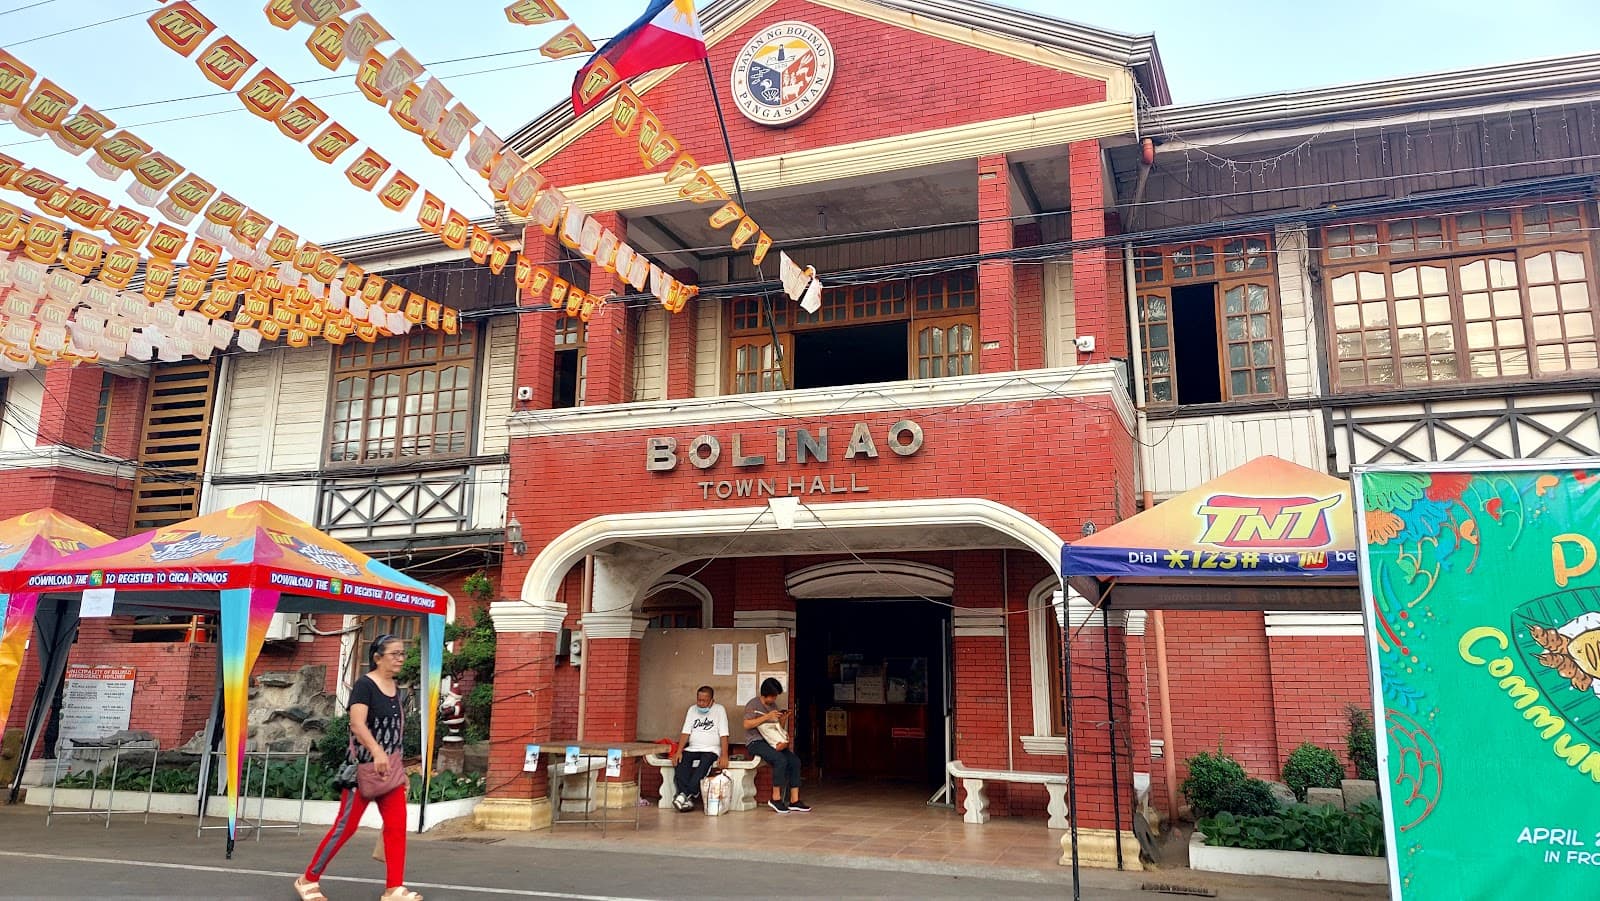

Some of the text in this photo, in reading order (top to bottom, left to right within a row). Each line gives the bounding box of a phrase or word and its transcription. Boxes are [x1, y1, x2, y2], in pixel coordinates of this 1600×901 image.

[156, 9, 207, 40] TNT
[314, 25, 343, 55] TN
[738, 26, 826, 72] BAYAN NG BOLINAO
[204, 46, 248, 75] TNT
[360, 62, 378, 88] TN
[244, 81, 288, 107] TNT
[739, 77, 824, 118] PANGASINAN
[28, 93, 70, 118] TNT
[395, 93, 411, 118] TN
[615, 101, 637, 124] TNT
[63, 115, 104, 136] TNT
[279, 107, 320, 130] TNT
[103, 140, 144, 158] TNT
[314, 133, 350, 154] TNT
[136, 159, 177, 180] TNT
[351, 162, 384, 180] TNT
[21, 176, 59, 191] TNT
[174, 183, 210, 202] TNT
[384, 184, 413, 202] TNT
[66, 197, 105, 216] TNT
[212, 201, 242, 217] TNT
[422, 205, 441, 223] TNT
[109, 215, 142, 231] TNT
[28, 226, 61, 243] TNT
[152, 234, 184, 250] TNT
[72, 242, 101, 257] TNT
[189, 247, 218, 265] TNT
[272, 238, 294, 256] TNT
[108, 253, 134, 271] TNT
[298, 249, 318, 267] TNT
[149, 269, 171, 285] TNT
[232, 264, 254, 280] TNT
[181, 278, 203, 295] TNT
[264, 277, 283, 292] TNT
[213, 292, 236, 306] TNT
[248, 299, 266, 315] TNT
[275, 308, 292, 323] TNT
[646, 419, 924, 471] BOLINAO
[698, 473, 869, 500] TOWN HALL
[1197, 494, 1342, 544] TNT
[1128, 551, 1158, 564] Dial
[1268, 553, 1291, 564] for
[1298, 552, 1327, 568] TNT
[28, 575, 73, 586] DOWNLOAD
[75, 575, 88, 585] THE
[105, 574, 115, 583] TO
[118, 573, 154, 583] REGISTER
[157, 573, 166, 583] TO
[169, 573, 189, 583] GIGA
[192, 573, 228, 583] PROMOS
[271, 573, 313, 588] DOWNLOAD
[316, 579, 328, 590] THE
[343, 584, 353, 594] TO
[354, 586, 383, 599] REGISTER
[385, 591, 393, 600] TO
[395, 593, 410, 603] GIGA
[411, 596, 436, 608] PROMOS
[1516, 826, 1585, 846] APRIL
[1544, 850, 1561, 863] IN
